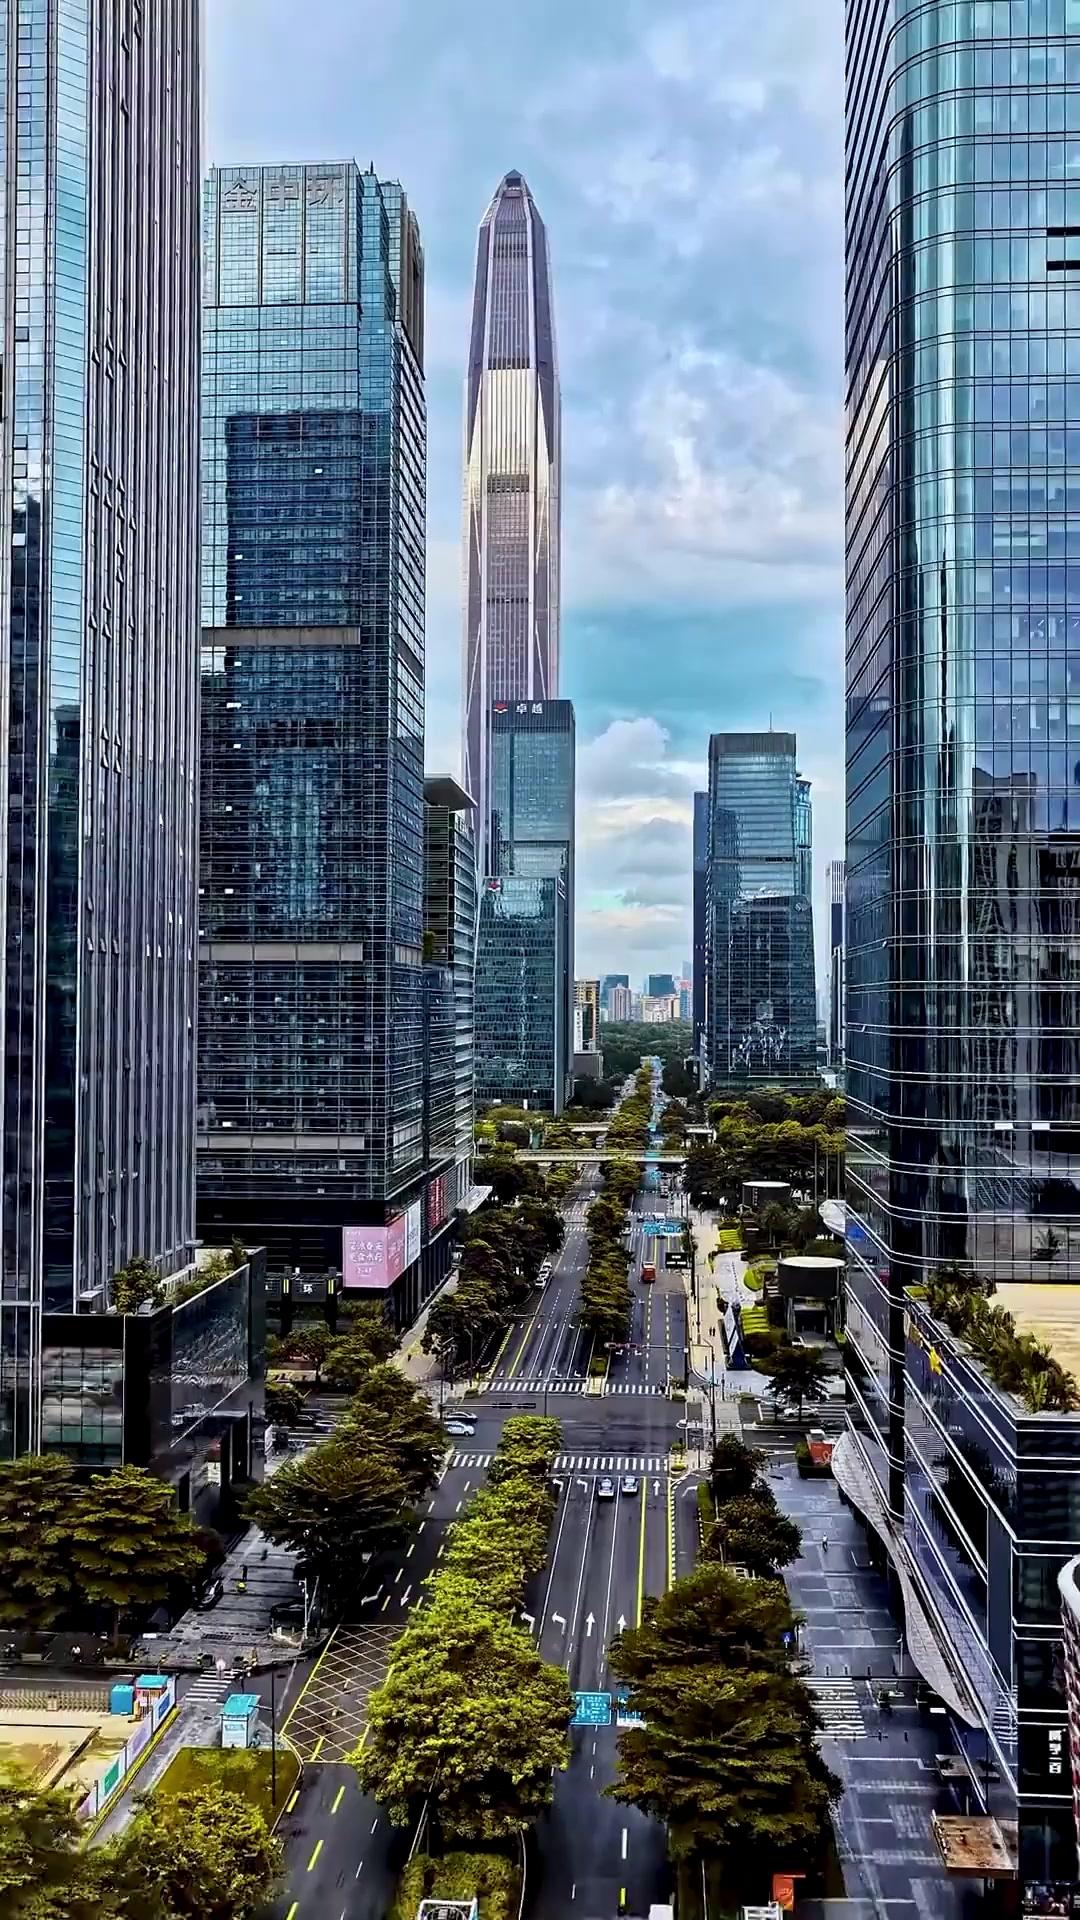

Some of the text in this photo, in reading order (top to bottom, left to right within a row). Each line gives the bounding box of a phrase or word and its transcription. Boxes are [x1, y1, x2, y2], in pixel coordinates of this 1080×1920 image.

[222, 174, 344, 212] 金中环
[515, 703, 543, 714] 卓越
